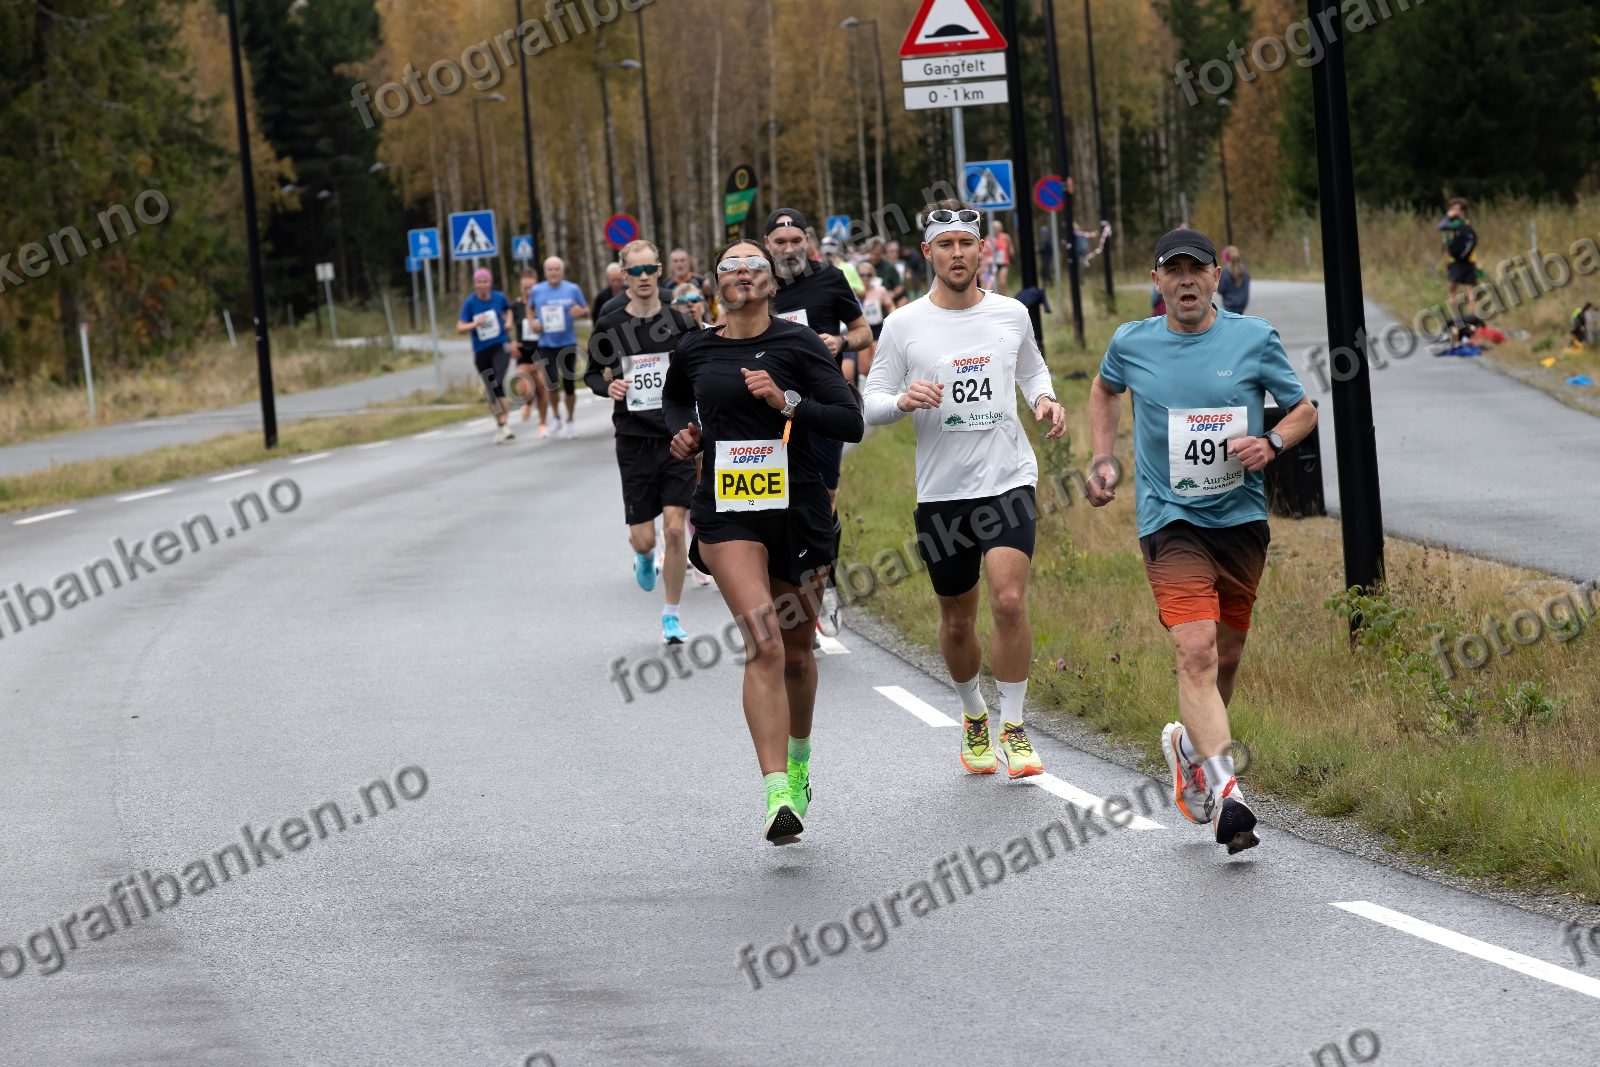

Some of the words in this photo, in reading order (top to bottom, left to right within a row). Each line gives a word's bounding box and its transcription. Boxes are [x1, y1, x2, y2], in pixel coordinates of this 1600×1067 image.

[923, 60, 986, 77] Gangfelt
[952, 355, 991, 367] NORGES
[956, 364, 985, 374] LØPET
[634, 372, 662, 390] 565
[952, 377, 993, 403] 624
[968, 411, 1003, 421] Aurskog
[1186, 414, 1233, 423] NORGES
[1190, 423, 1225, 432] LØPET
[729, 446, 774, 456] NORGES
[1184, 438, 1229, 466] 491
[732, 454, 767, 464] LØPET
[1203, 470, 1242, 485] Aurskog
[722, 472, 782, 496] PACE
